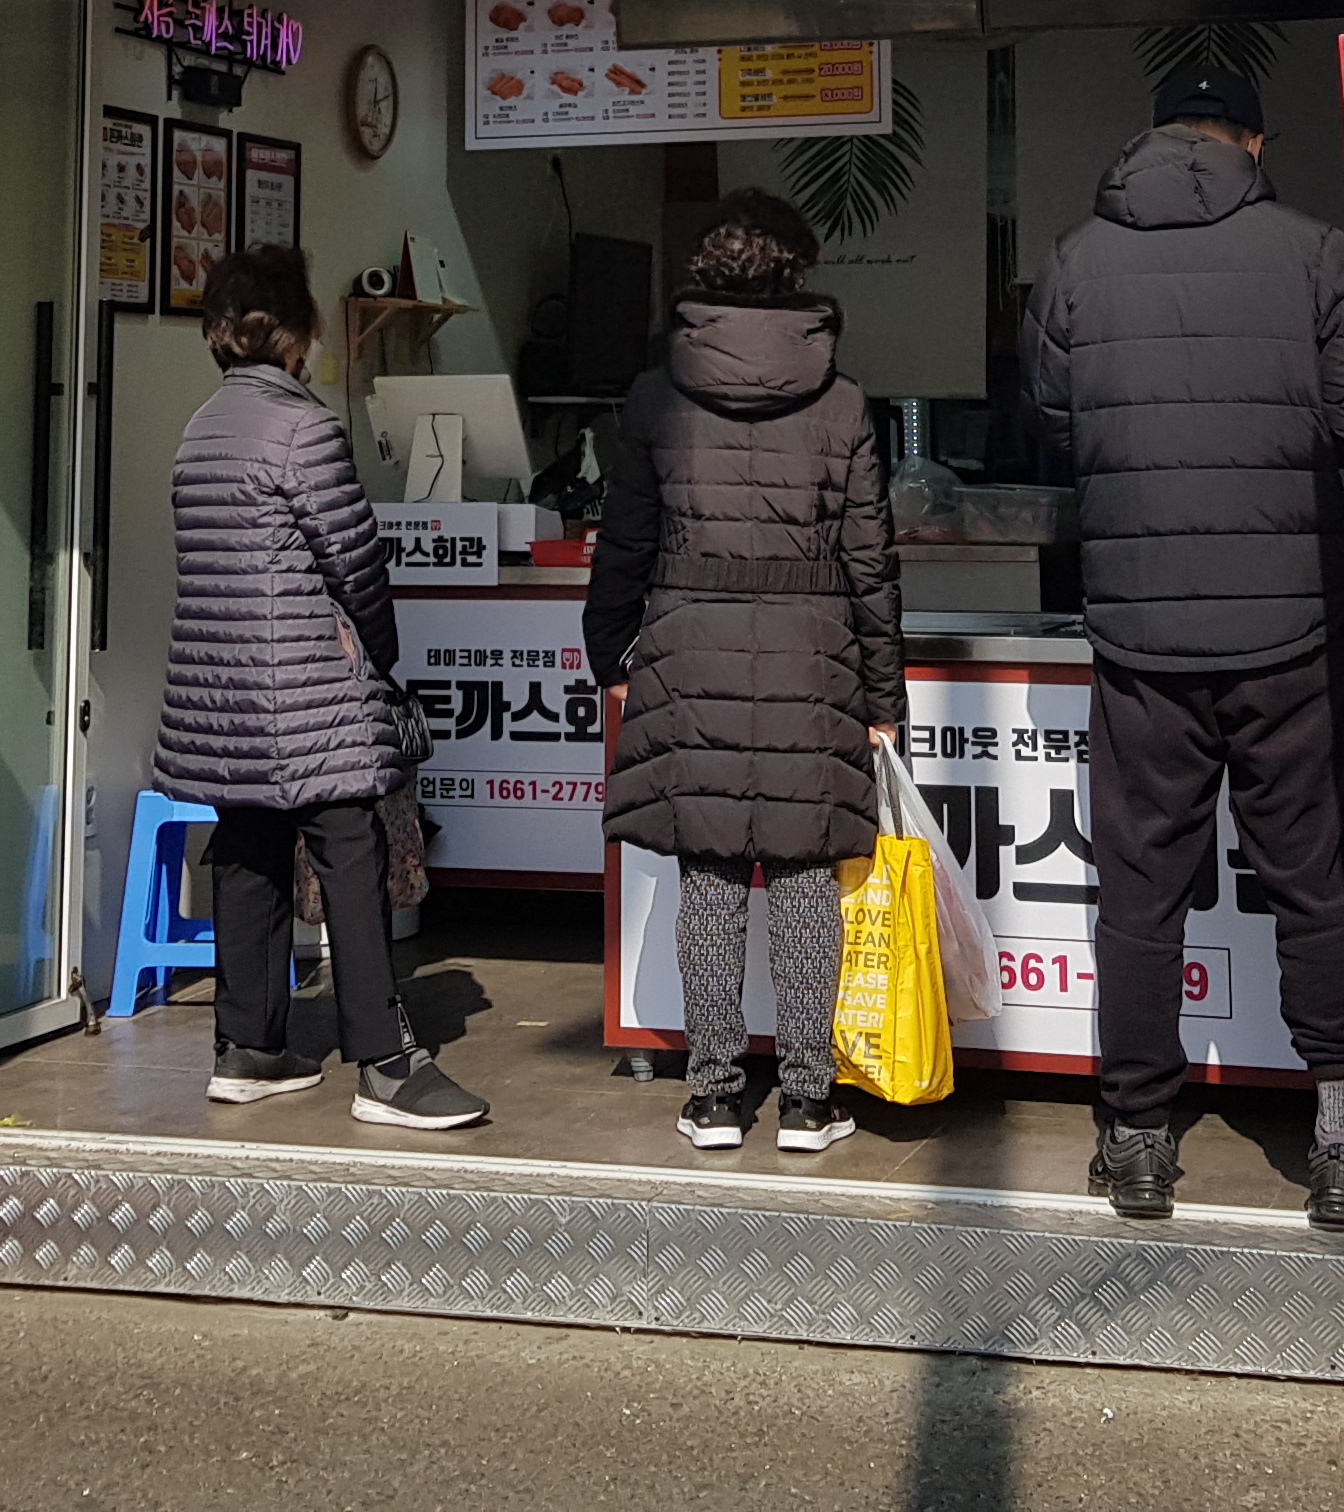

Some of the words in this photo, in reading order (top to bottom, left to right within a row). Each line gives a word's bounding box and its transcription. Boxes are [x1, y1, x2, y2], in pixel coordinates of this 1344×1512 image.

[426, 647, 505, 669] 테이크아웃
[509, 647, 557, 669] 전문점
[417, 776, 476, 801] 업문의
[485, 778, 605, 804] 1661-2779
[844, 906, 892, 929] LOVE
